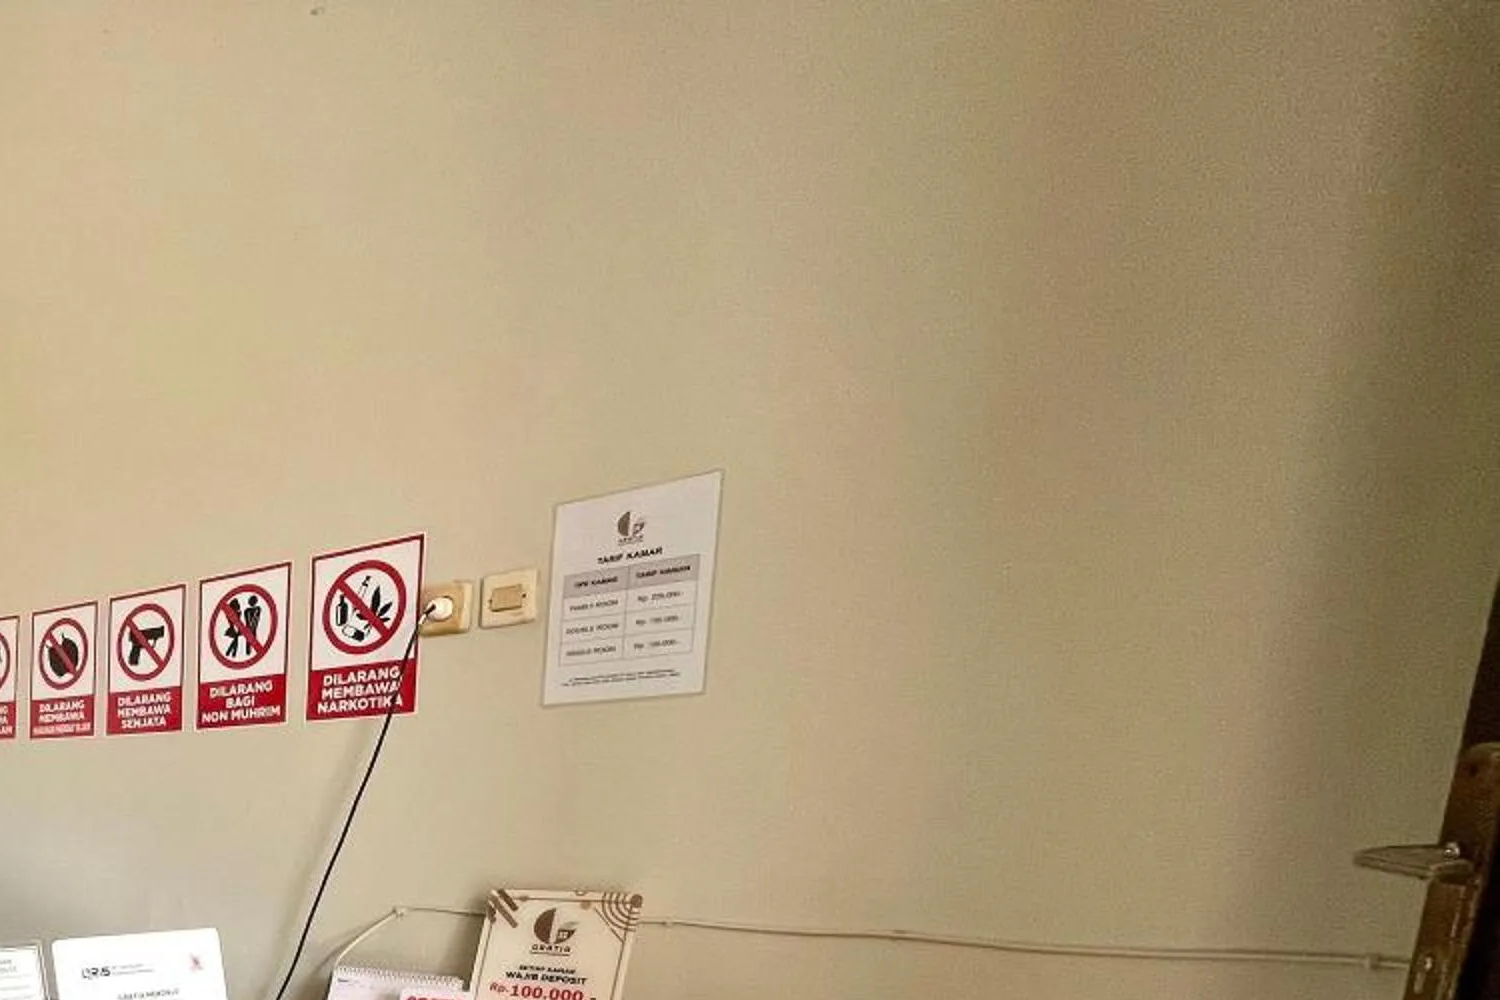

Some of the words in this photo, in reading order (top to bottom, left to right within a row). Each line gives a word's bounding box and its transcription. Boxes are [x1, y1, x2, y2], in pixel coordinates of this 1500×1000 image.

[626, 547, 662, 560] KAMAR
[323, 665, 401, 687] DILARANG
[210, 680, 273, 698] DILARANG
[322, 681, 400, 700] MEMBAWA
[117, 692, 171, 707] DILARANG
[225, 696, 255, 709] BAGI
[317, 694, 403, 714] NARKOTIKA
[117, 704, 171, 718] MEMBAWA
[202, 711, 228, 723] NON
[121, 719, 166, 729] SENJATA
[506, 971, 539, 981] WAJIB
[540, 973, 588, 985] DEPOSIT
